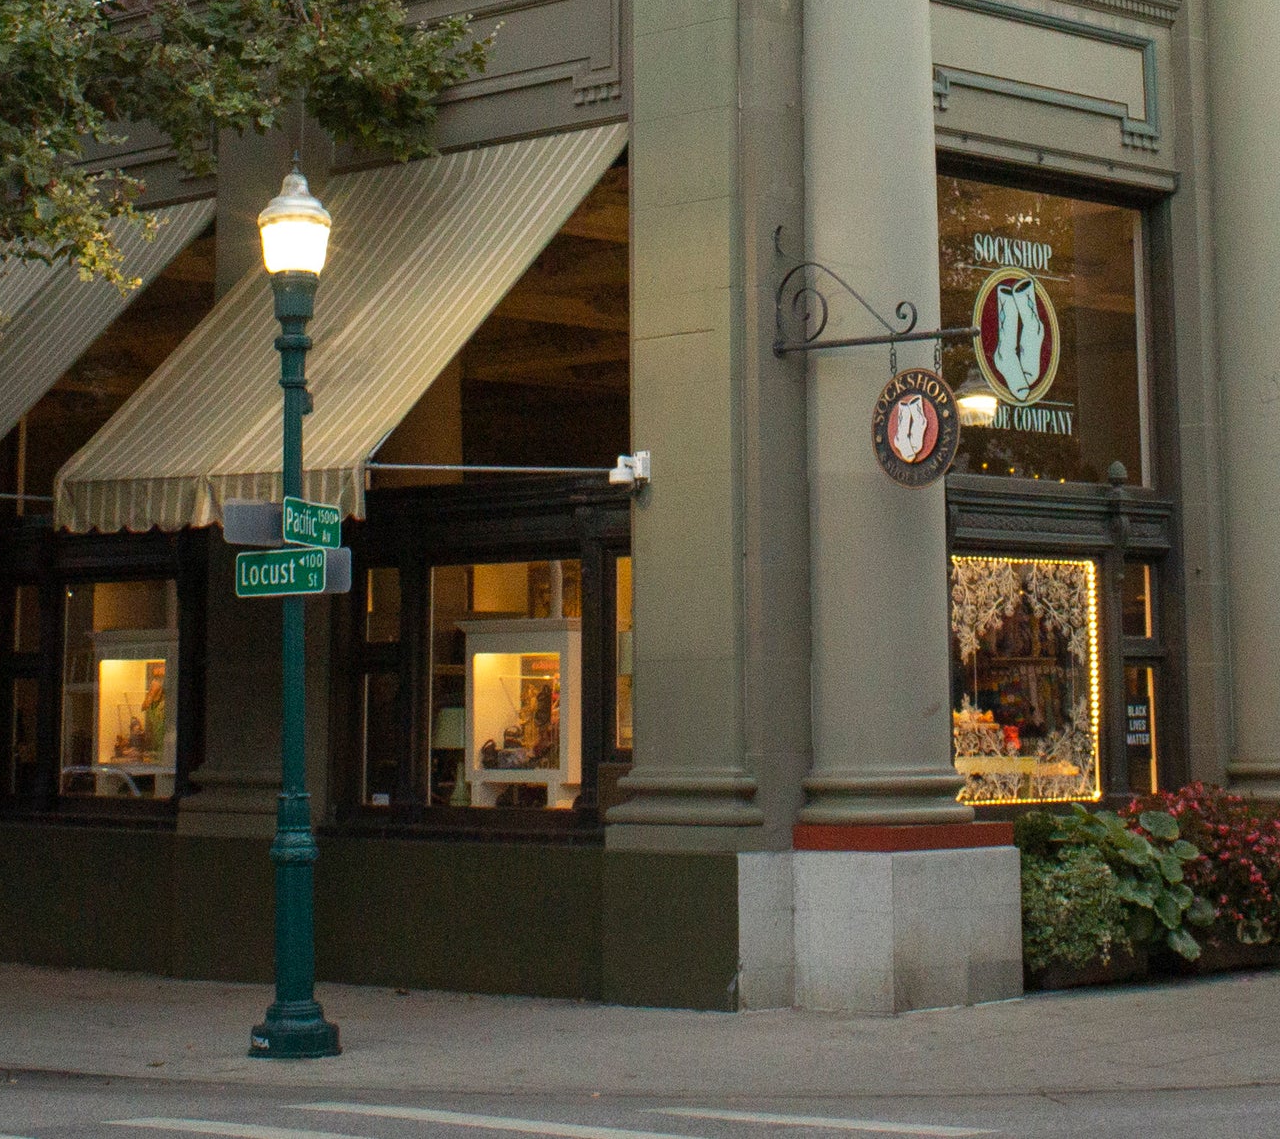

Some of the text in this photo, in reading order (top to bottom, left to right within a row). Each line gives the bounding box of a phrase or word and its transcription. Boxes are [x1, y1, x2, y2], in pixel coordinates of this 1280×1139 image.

[974, 233, 1052, 270] SOCKSHOP
[874, 374, 947, 425] SOCKSHOP
[1014, 406, 1074, 436] COMPANY
[286, 506, 334, 537] Pacific 1500
[322, 529, 331, 543] Av
[241, 554, 323, 586] Locust 100
[308, 573, 317, 587] St
[1127, 705, 1147, 717] BLACK
[1129, 719, 1146, 731] LIVES
[1126, 733, 1150, 745] MATTER
